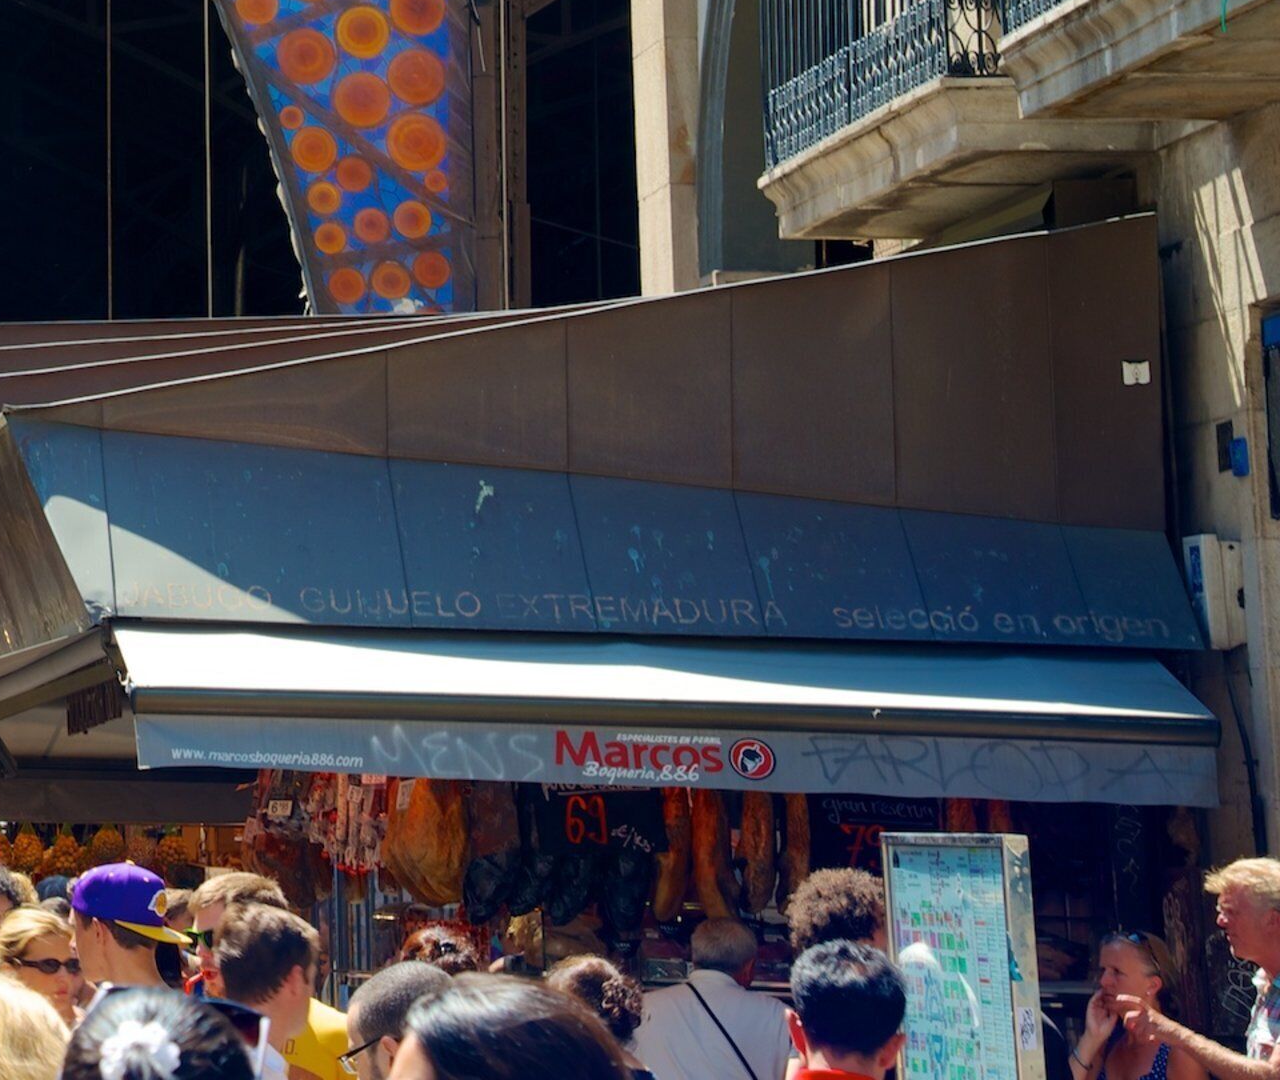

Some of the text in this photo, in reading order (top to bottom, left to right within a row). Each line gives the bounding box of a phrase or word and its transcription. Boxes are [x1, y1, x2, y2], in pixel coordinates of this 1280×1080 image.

[496, 593, 789, 626] EXTREMADURA
[1053, 610, 1169, 643] origen
[555, 730, 724, 773] Marcos
